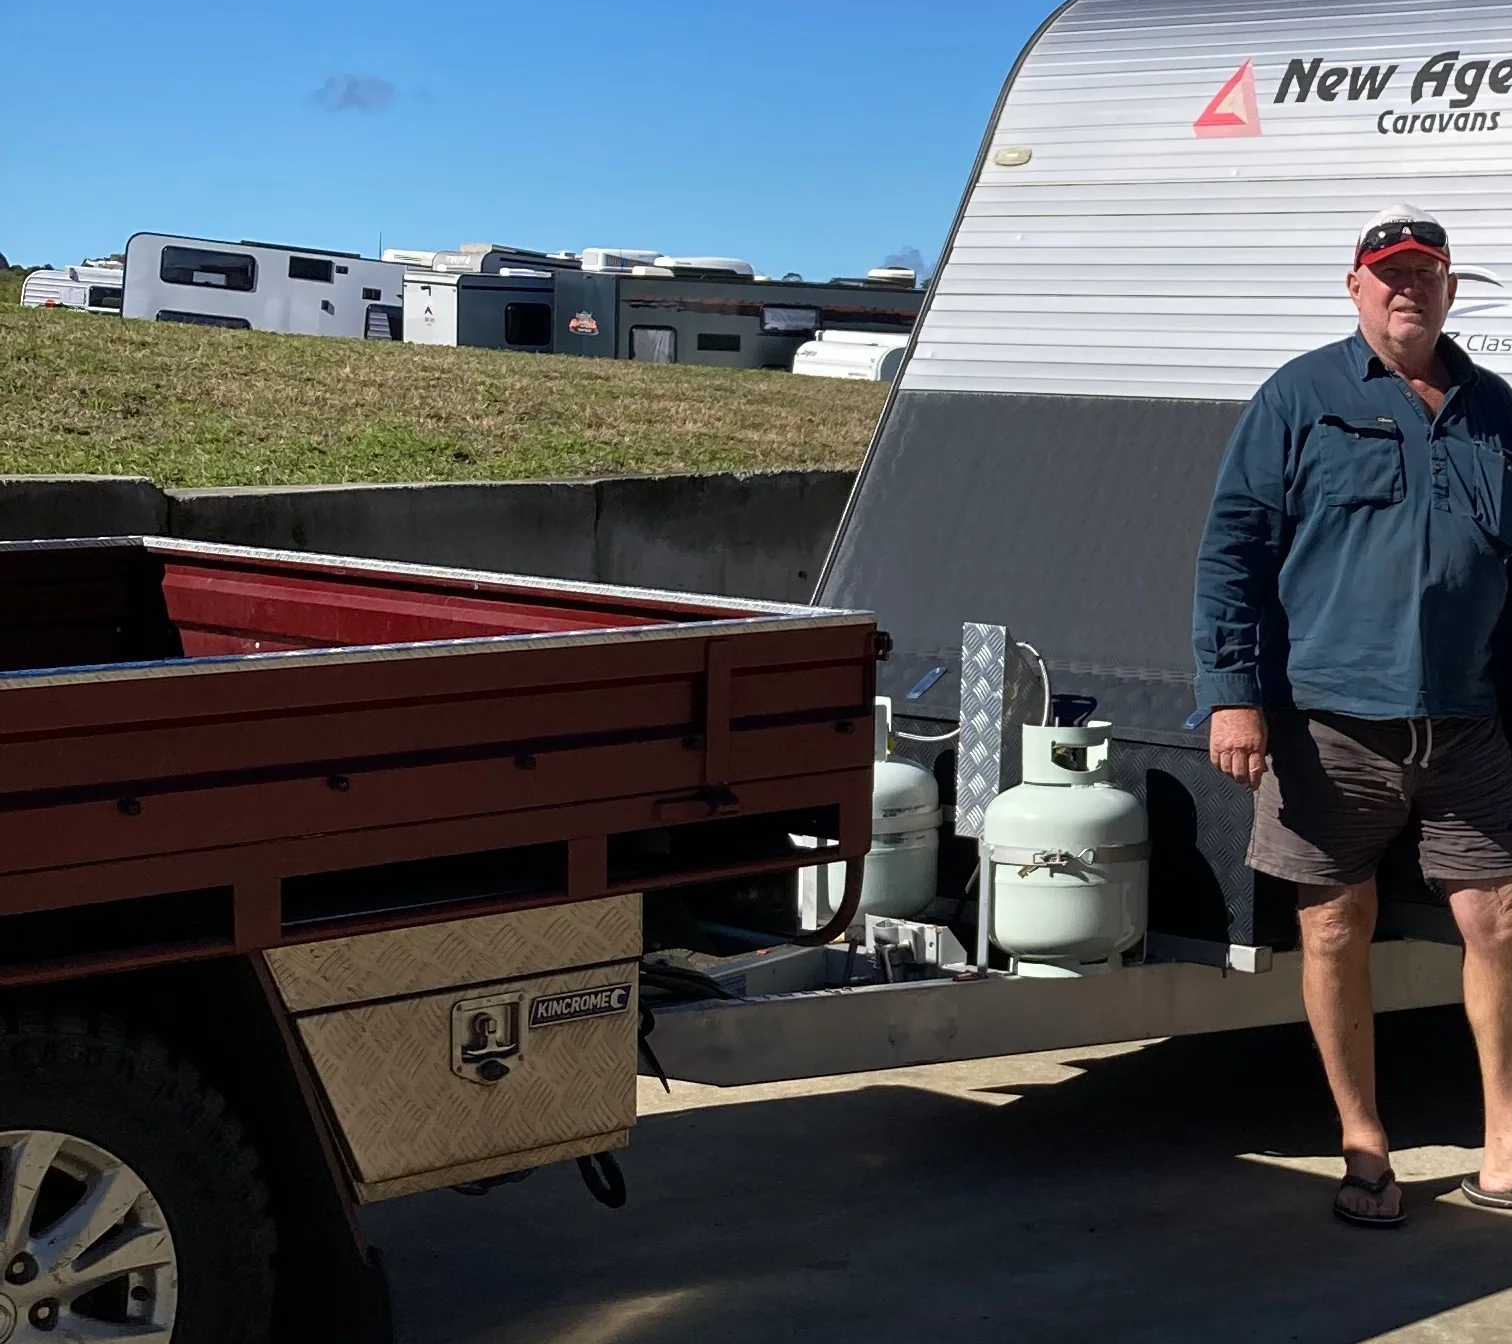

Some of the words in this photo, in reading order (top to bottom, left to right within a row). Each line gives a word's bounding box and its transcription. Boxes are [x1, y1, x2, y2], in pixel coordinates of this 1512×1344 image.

[1273, 57, 1400, 104] New
[1377, 109, 1501, 134] Caravans
[536, 991, 611, 1018] KINCROME
